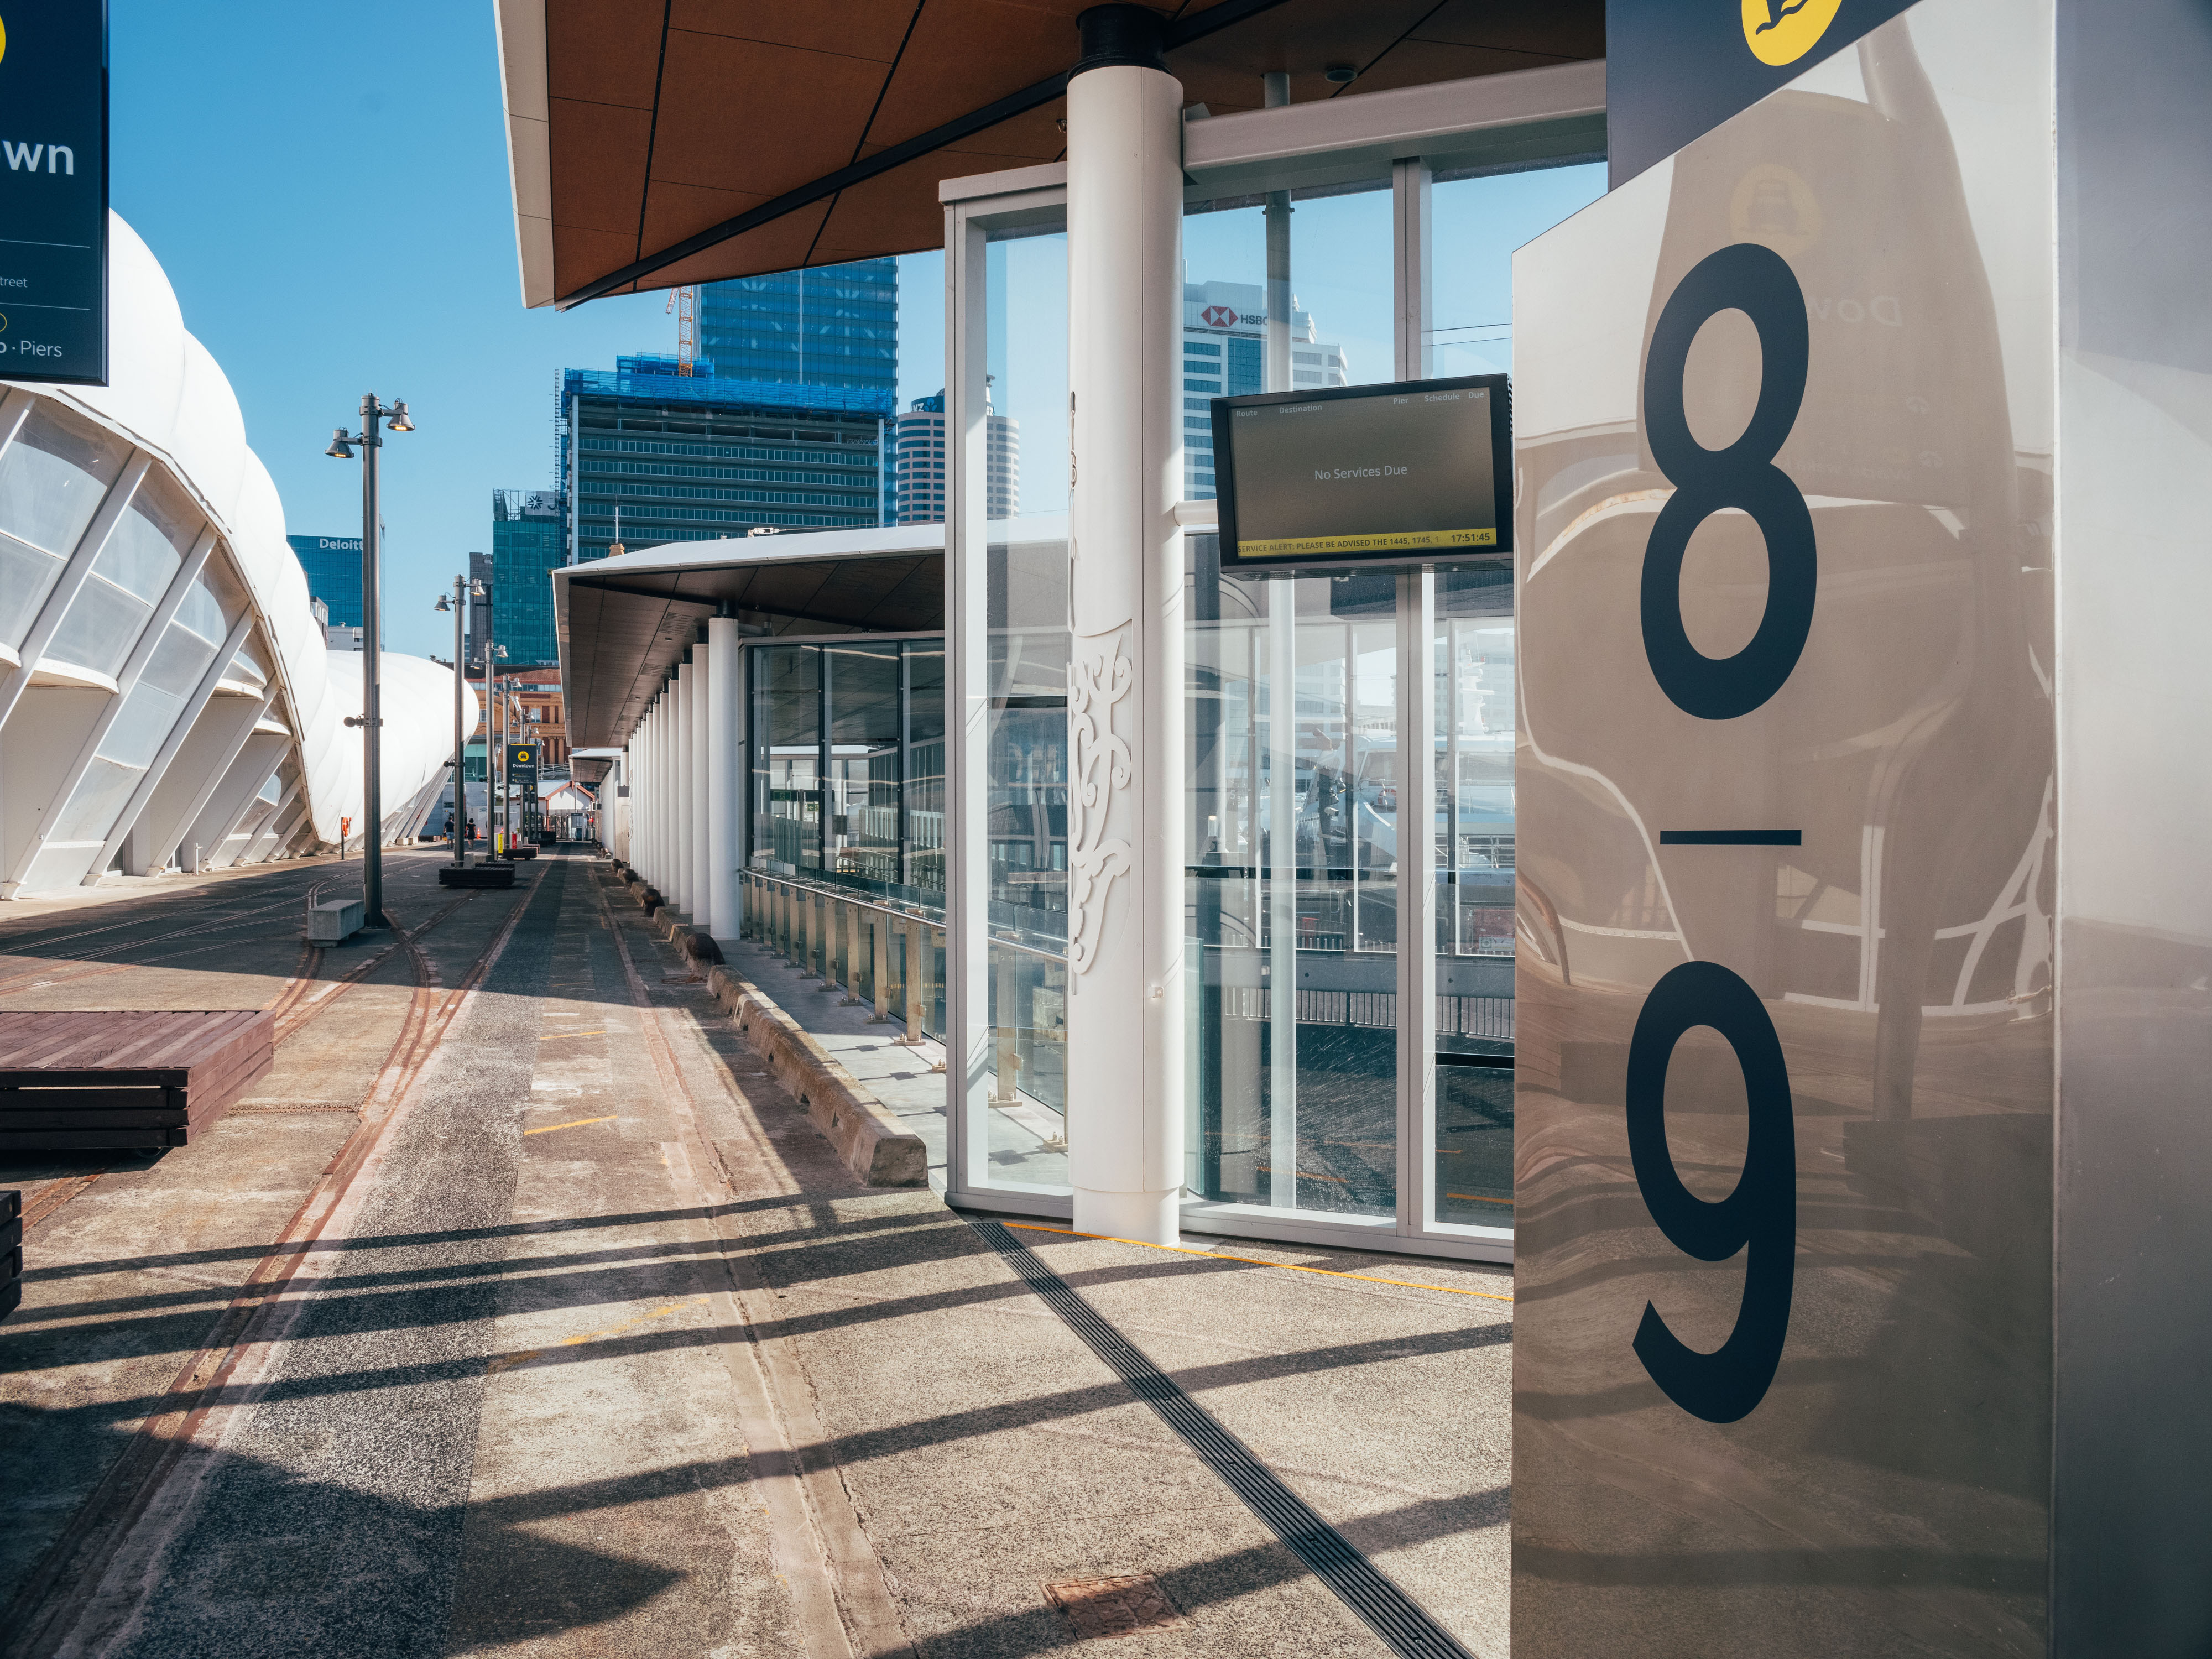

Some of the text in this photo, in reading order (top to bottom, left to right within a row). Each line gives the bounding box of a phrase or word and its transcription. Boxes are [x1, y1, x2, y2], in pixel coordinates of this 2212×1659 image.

[20, 340, 62, 357] Piers
[911, 403, 924, 412] NZ
[1279, 404, 1322, 414] Destination
[1425, 393, 1460, 402] Schedule
[1314, 465, 1407, 481] No Services Due
[1641, 243, 1817, 719] 8
[1451, 533, 1490, 542] 17:51:45
[1626, 961, 1796, 1423] 9
